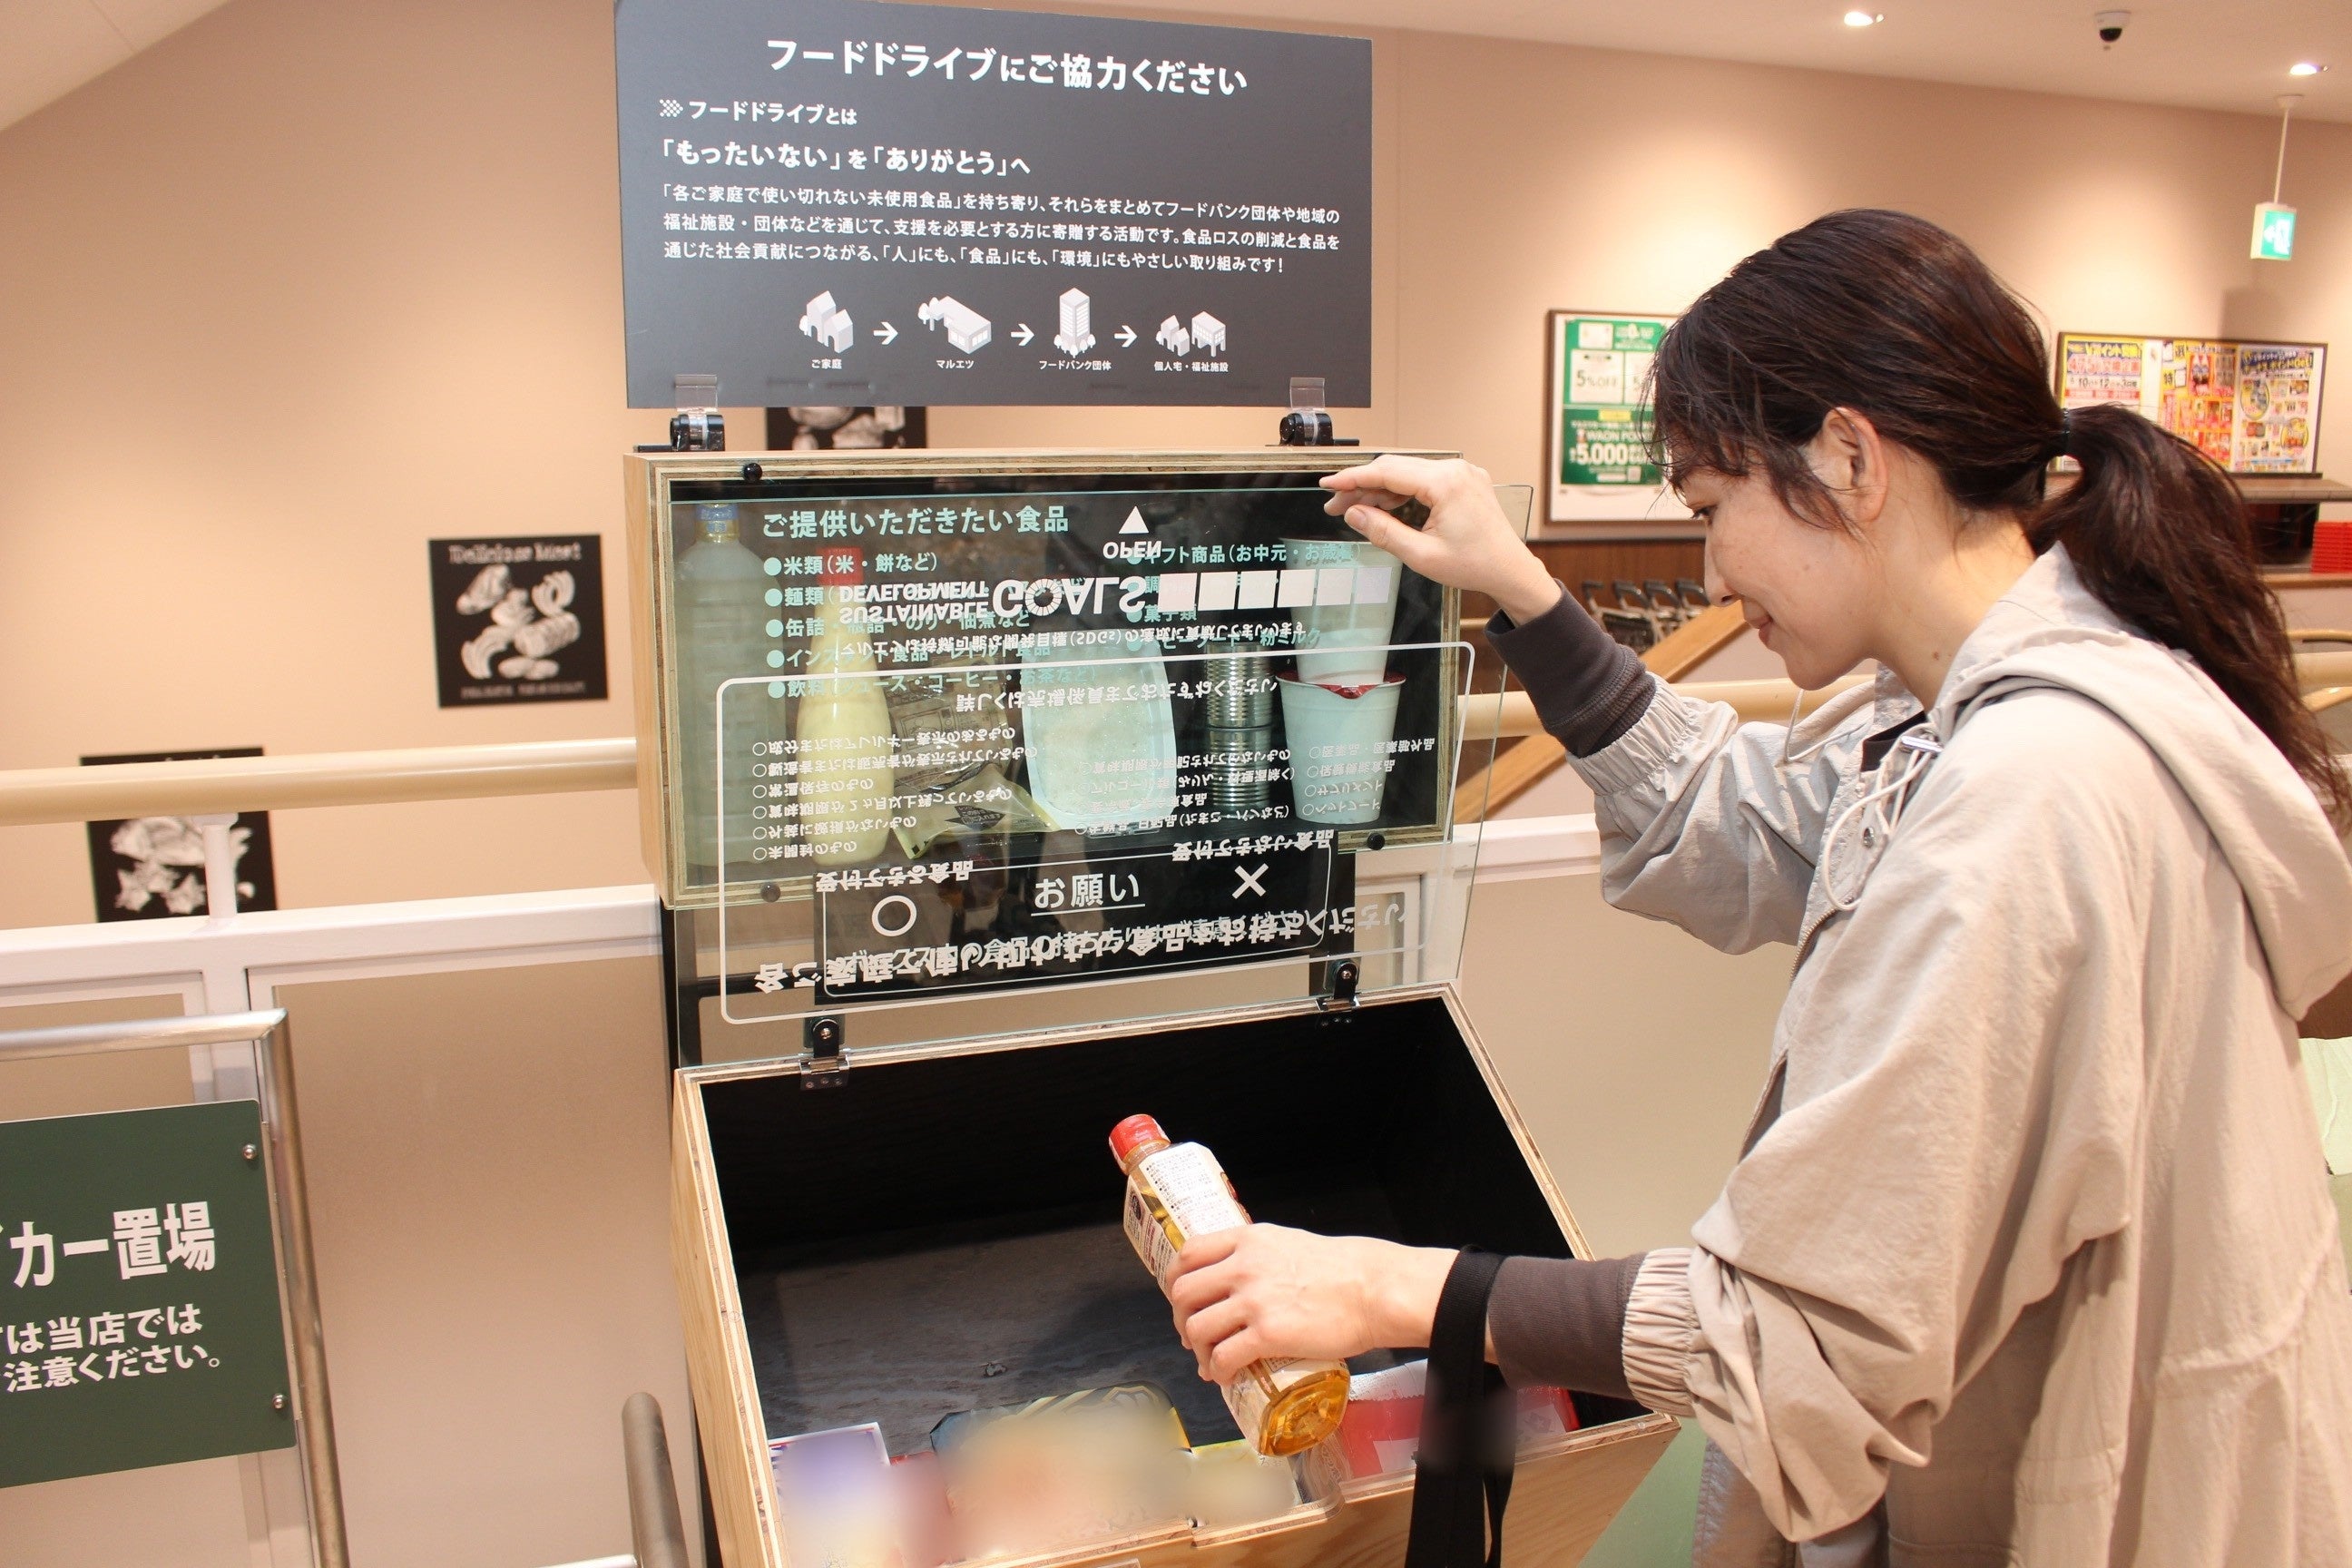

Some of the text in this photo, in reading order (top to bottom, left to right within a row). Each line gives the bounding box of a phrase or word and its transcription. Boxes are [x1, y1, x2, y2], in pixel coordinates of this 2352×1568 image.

[767, 39, 1248, 95] フードドライブにご協力ください
[689, 100, 858, 125] フードドライブとは
[663, 138, 1031, 176] 「もったいない」を「ありがとう」へ
[663, 184, 1340, 224] 「各ご家庭で使い切れない未使用食品」を持ち寄り、それらをまとめてフードバンク団体や地域の
[663, 213, 1340, 250] 福祉施設・団体などを通じて、支援を必要とする方に寄贈する活動です。食品ロスの削減と食品を
[810, 358, 843, 370] ご家庭
[936, 359, 975, 370] マルエツ
[1039, 359, 1112, 371] フードバンク団体
[1153, 361, 1230, 373] 個人宅・福祉施設
[763, 505, 1070, 539] ご提供いただきたい食品
[784, 552, 938, 575] 米類（米・餅など）
[1034, 873, 1142, 908] お願い
[0, 1200, 216, 1288] カー置場
[0, 1303, 203, 1354] は当店では
[4, 1345, 220, 1393] 注意ください。
